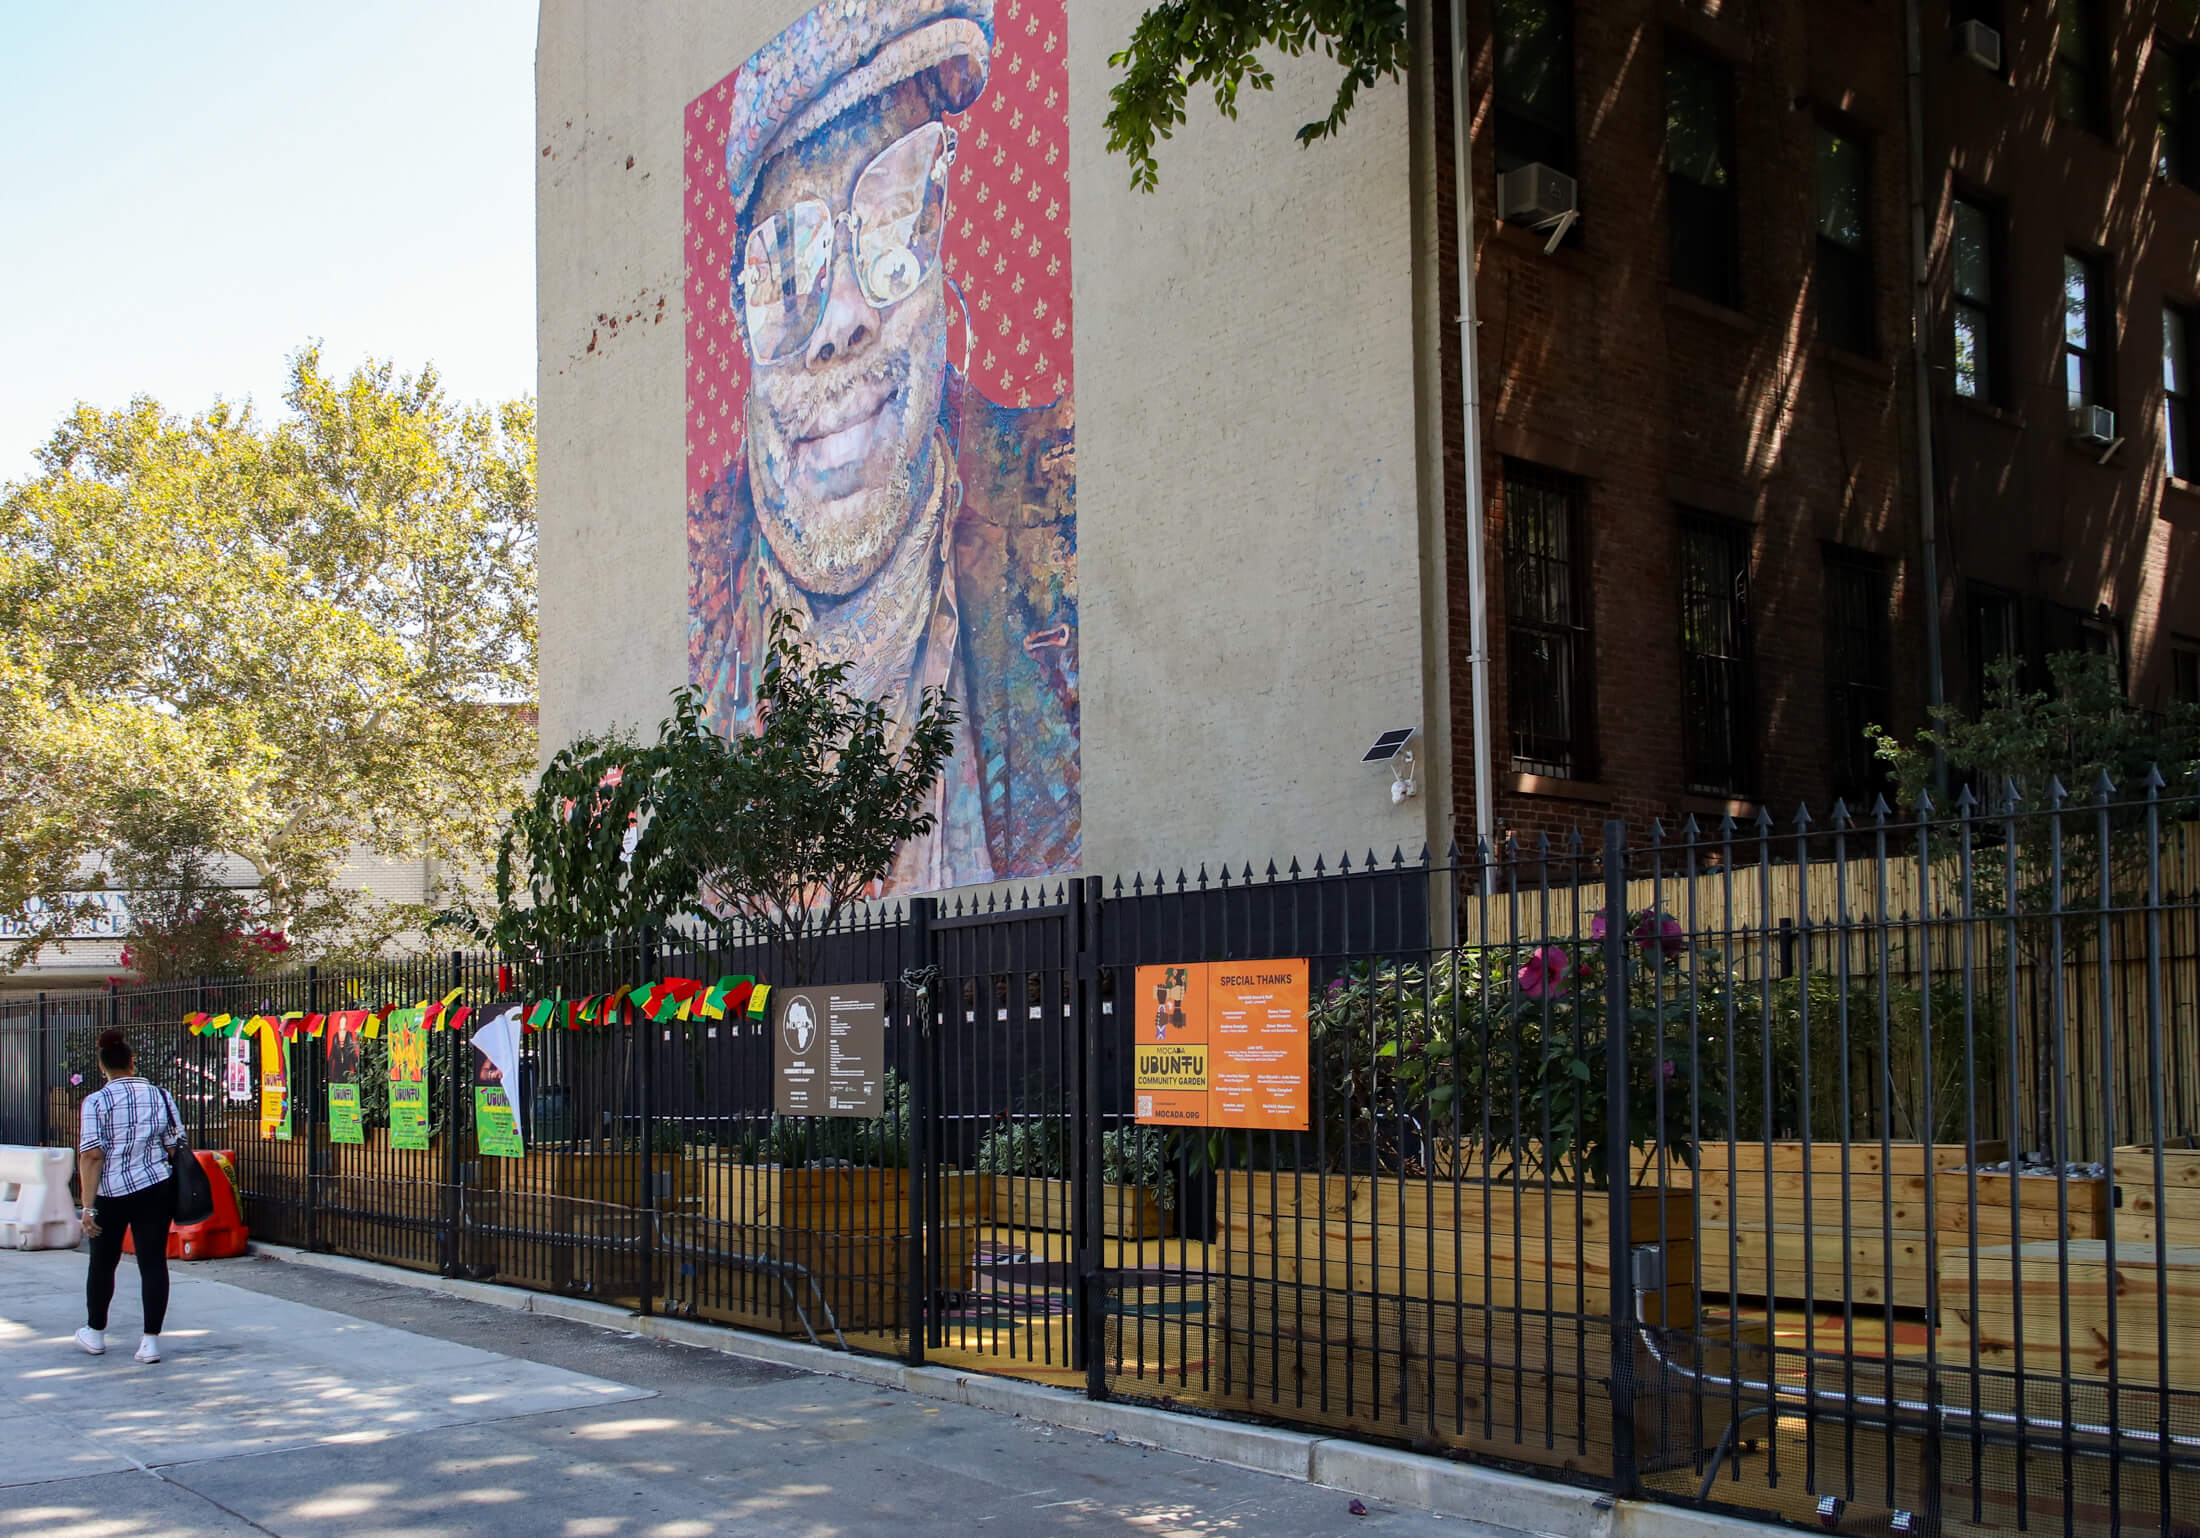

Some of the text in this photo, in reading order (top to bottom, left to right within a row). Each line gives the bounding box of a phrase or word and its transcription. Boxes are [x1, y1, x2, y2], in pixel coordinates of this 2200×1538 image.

[1220, 974, 1292, 986] SPECIAL THANKS
[1140, 1056, 1203, 1075] UBUNTU
[1138, 1076, 1206, 1086] COMMUNITY GARDEN
[1155, 1110, 1200, 1119] MOCADA.ORG
